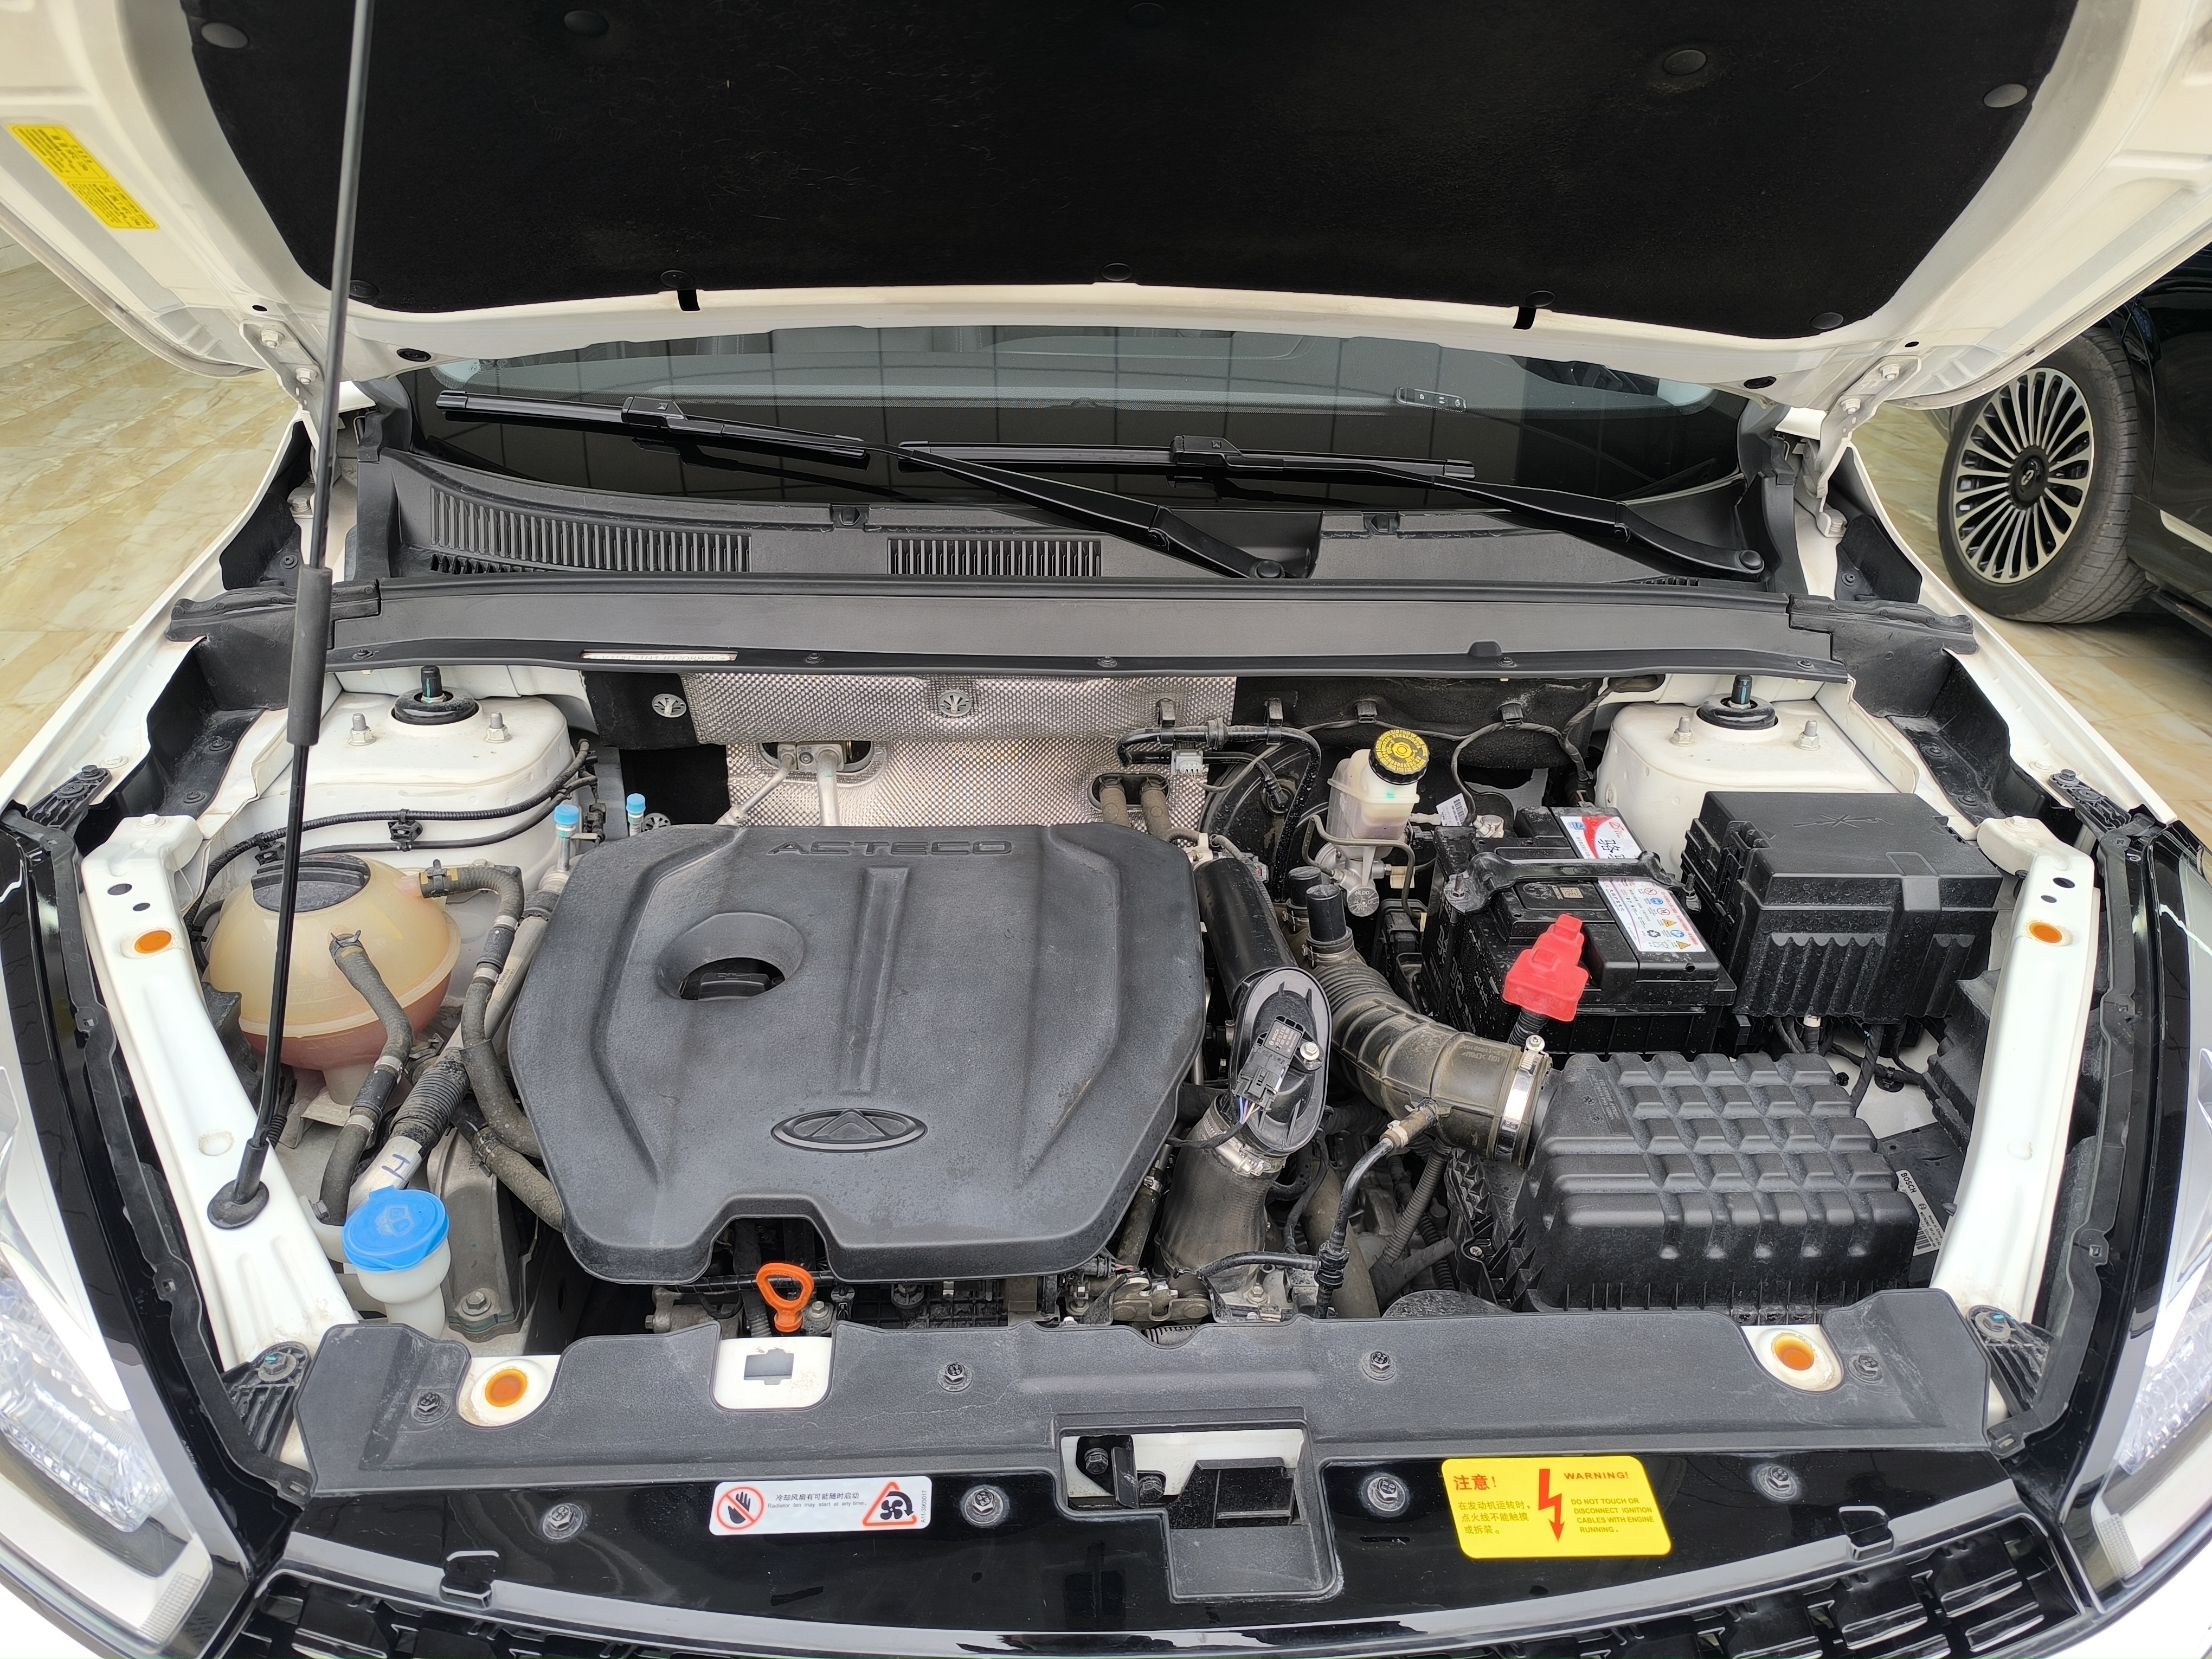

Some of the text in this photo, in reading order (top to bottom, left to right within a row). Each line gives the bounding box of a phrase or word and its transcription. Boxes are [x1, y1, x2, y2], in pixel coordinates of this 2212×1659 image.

[767, 840, 1012, 856] ACTECO
[1900, 1172, 1918, 1193] BOSCH
[1564, 1471, 1629, 1480] WARNING!
[1453, 1474, 1497, 1491] 注意！
[775, 1491, 859, 1501] 冷却风扇有可能随时启动
[1458, 1501, 1531, 1511] 在发动机运转时，
[1461, 1512, 1529, 1522] 点火线不能触摸
[1464, 1525, 1500, 1535] 或拆装。
